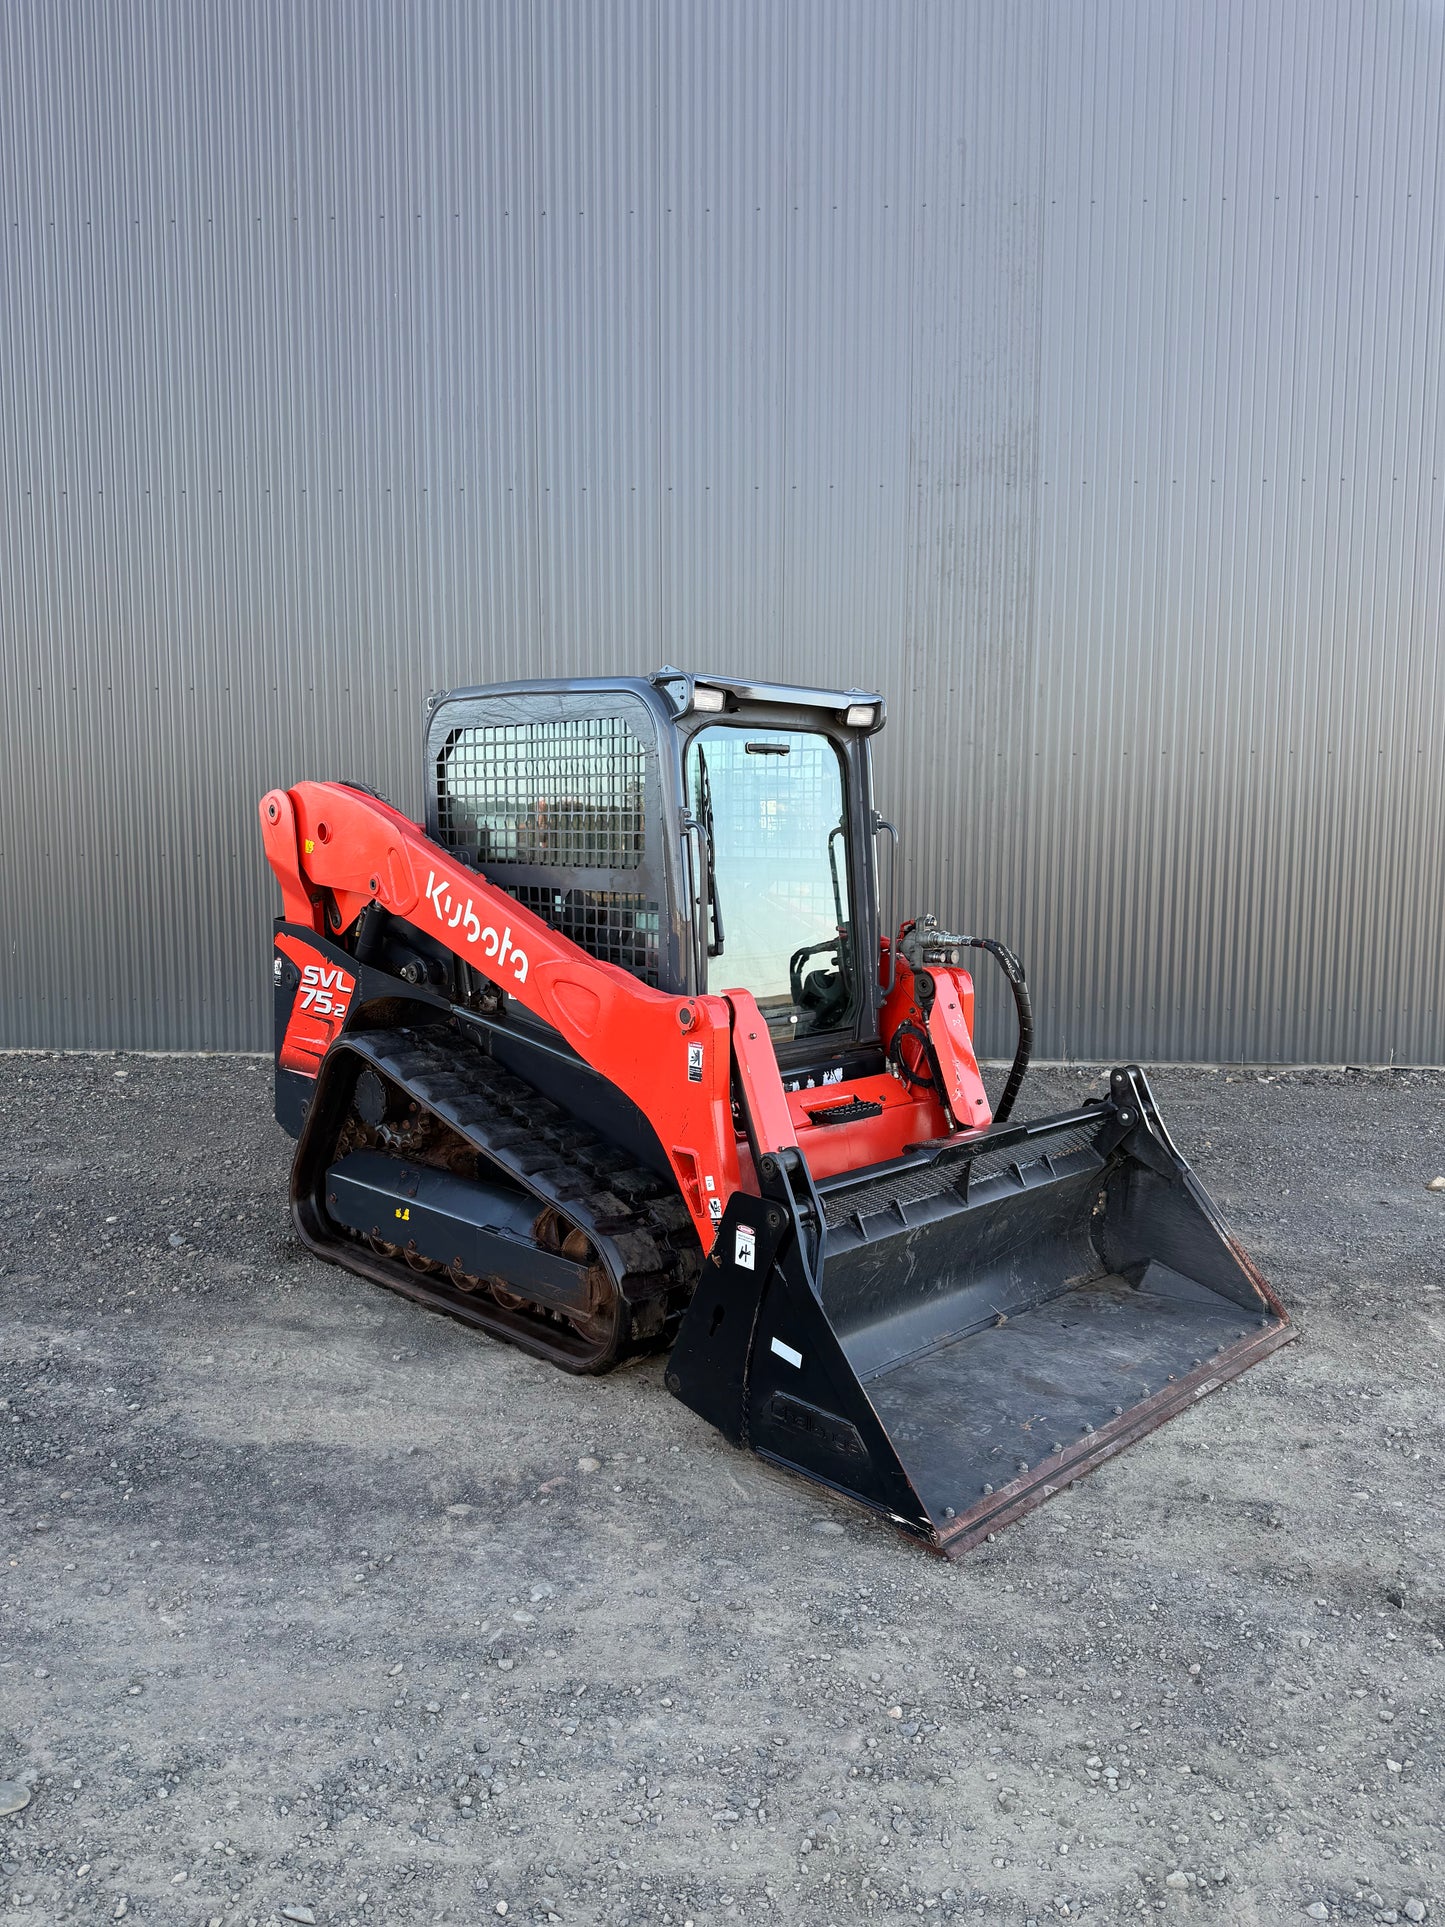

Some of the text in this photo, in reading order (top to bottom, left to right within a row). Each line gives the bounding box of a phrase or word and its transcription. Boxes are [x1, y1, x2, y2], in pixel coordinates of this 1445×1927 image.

[425, 870, 529, 984] Kubota
[301, 965, 352, 993] SVL
[300, 986, 346, 1018] 75-2
